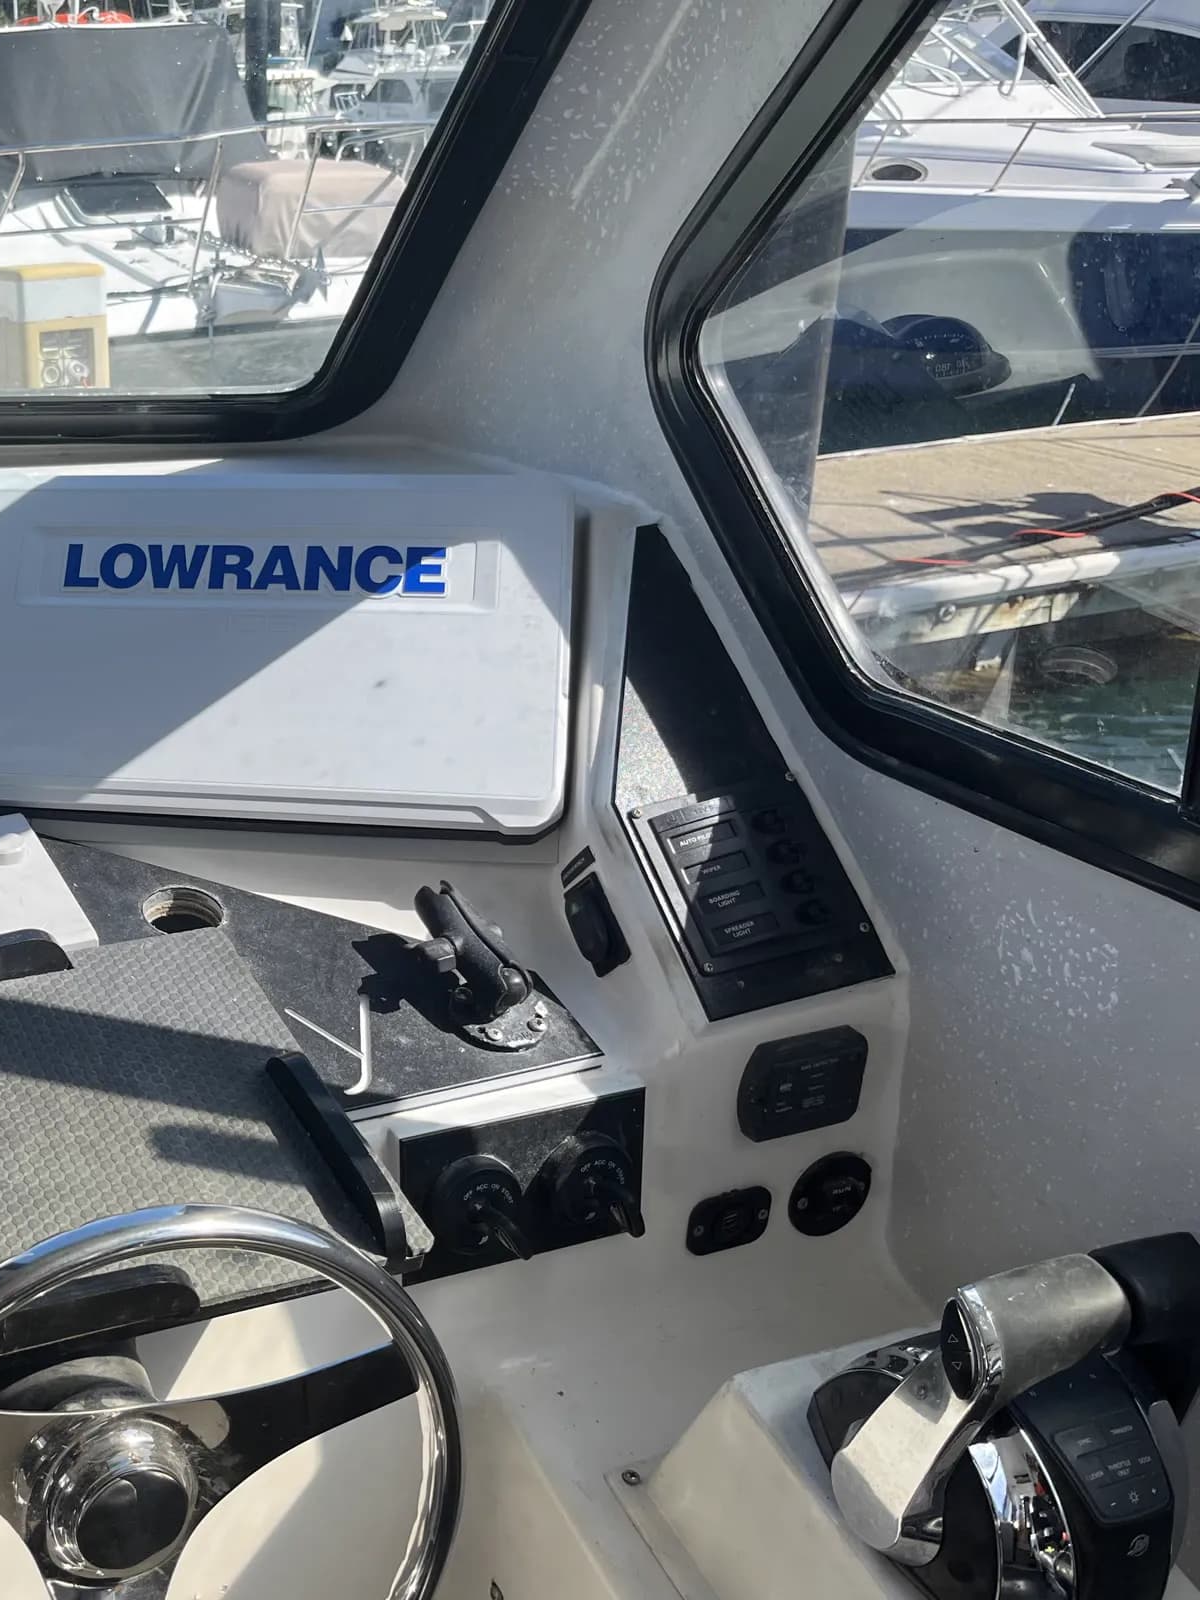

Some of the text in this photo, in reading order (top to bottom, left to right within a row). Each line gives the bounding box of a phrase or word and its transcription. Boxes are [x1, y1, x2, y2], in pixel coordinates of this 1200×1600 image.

[63, 543, 448, 595] LOWRANCE
[679, 836, 698, 847] AUTO
[708, 889, 741, 905] BOARDING
[717, 897, 737, 908] LIGHT
[732, 928, 752, 938] LIGHT
[476, 1183, 489, 1192] ACC
